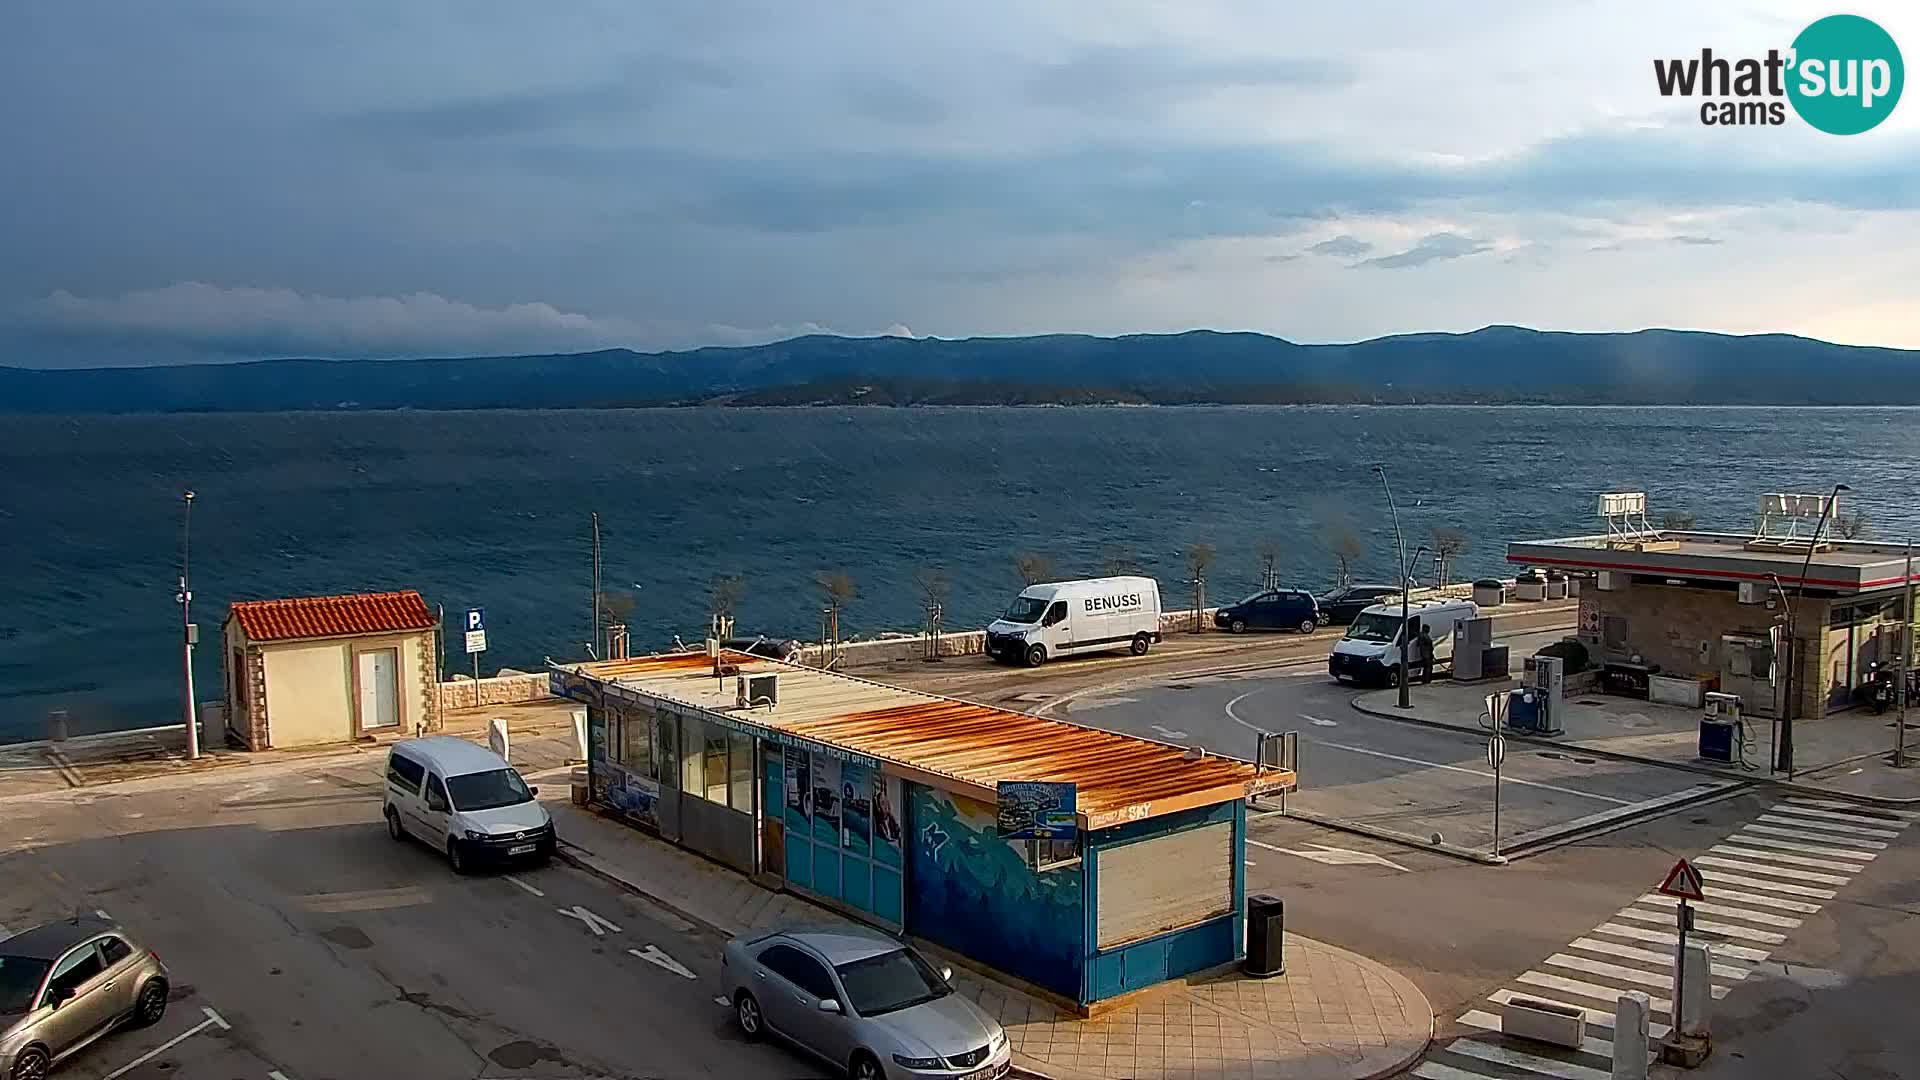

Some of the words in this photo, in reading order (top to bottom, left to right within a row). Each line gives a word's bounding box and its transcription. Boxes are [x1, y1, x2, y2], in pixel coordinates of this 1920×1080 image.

[1084, 593, 1141, 611] BENUSSI
[469, 611, 481, 629] P
[779, 734, 794, 745] BUS
[794, 738, 824, 754] STATION
[826, 747, 851, 761] TICKET
[852, 753, 878, 769] OFFICE
